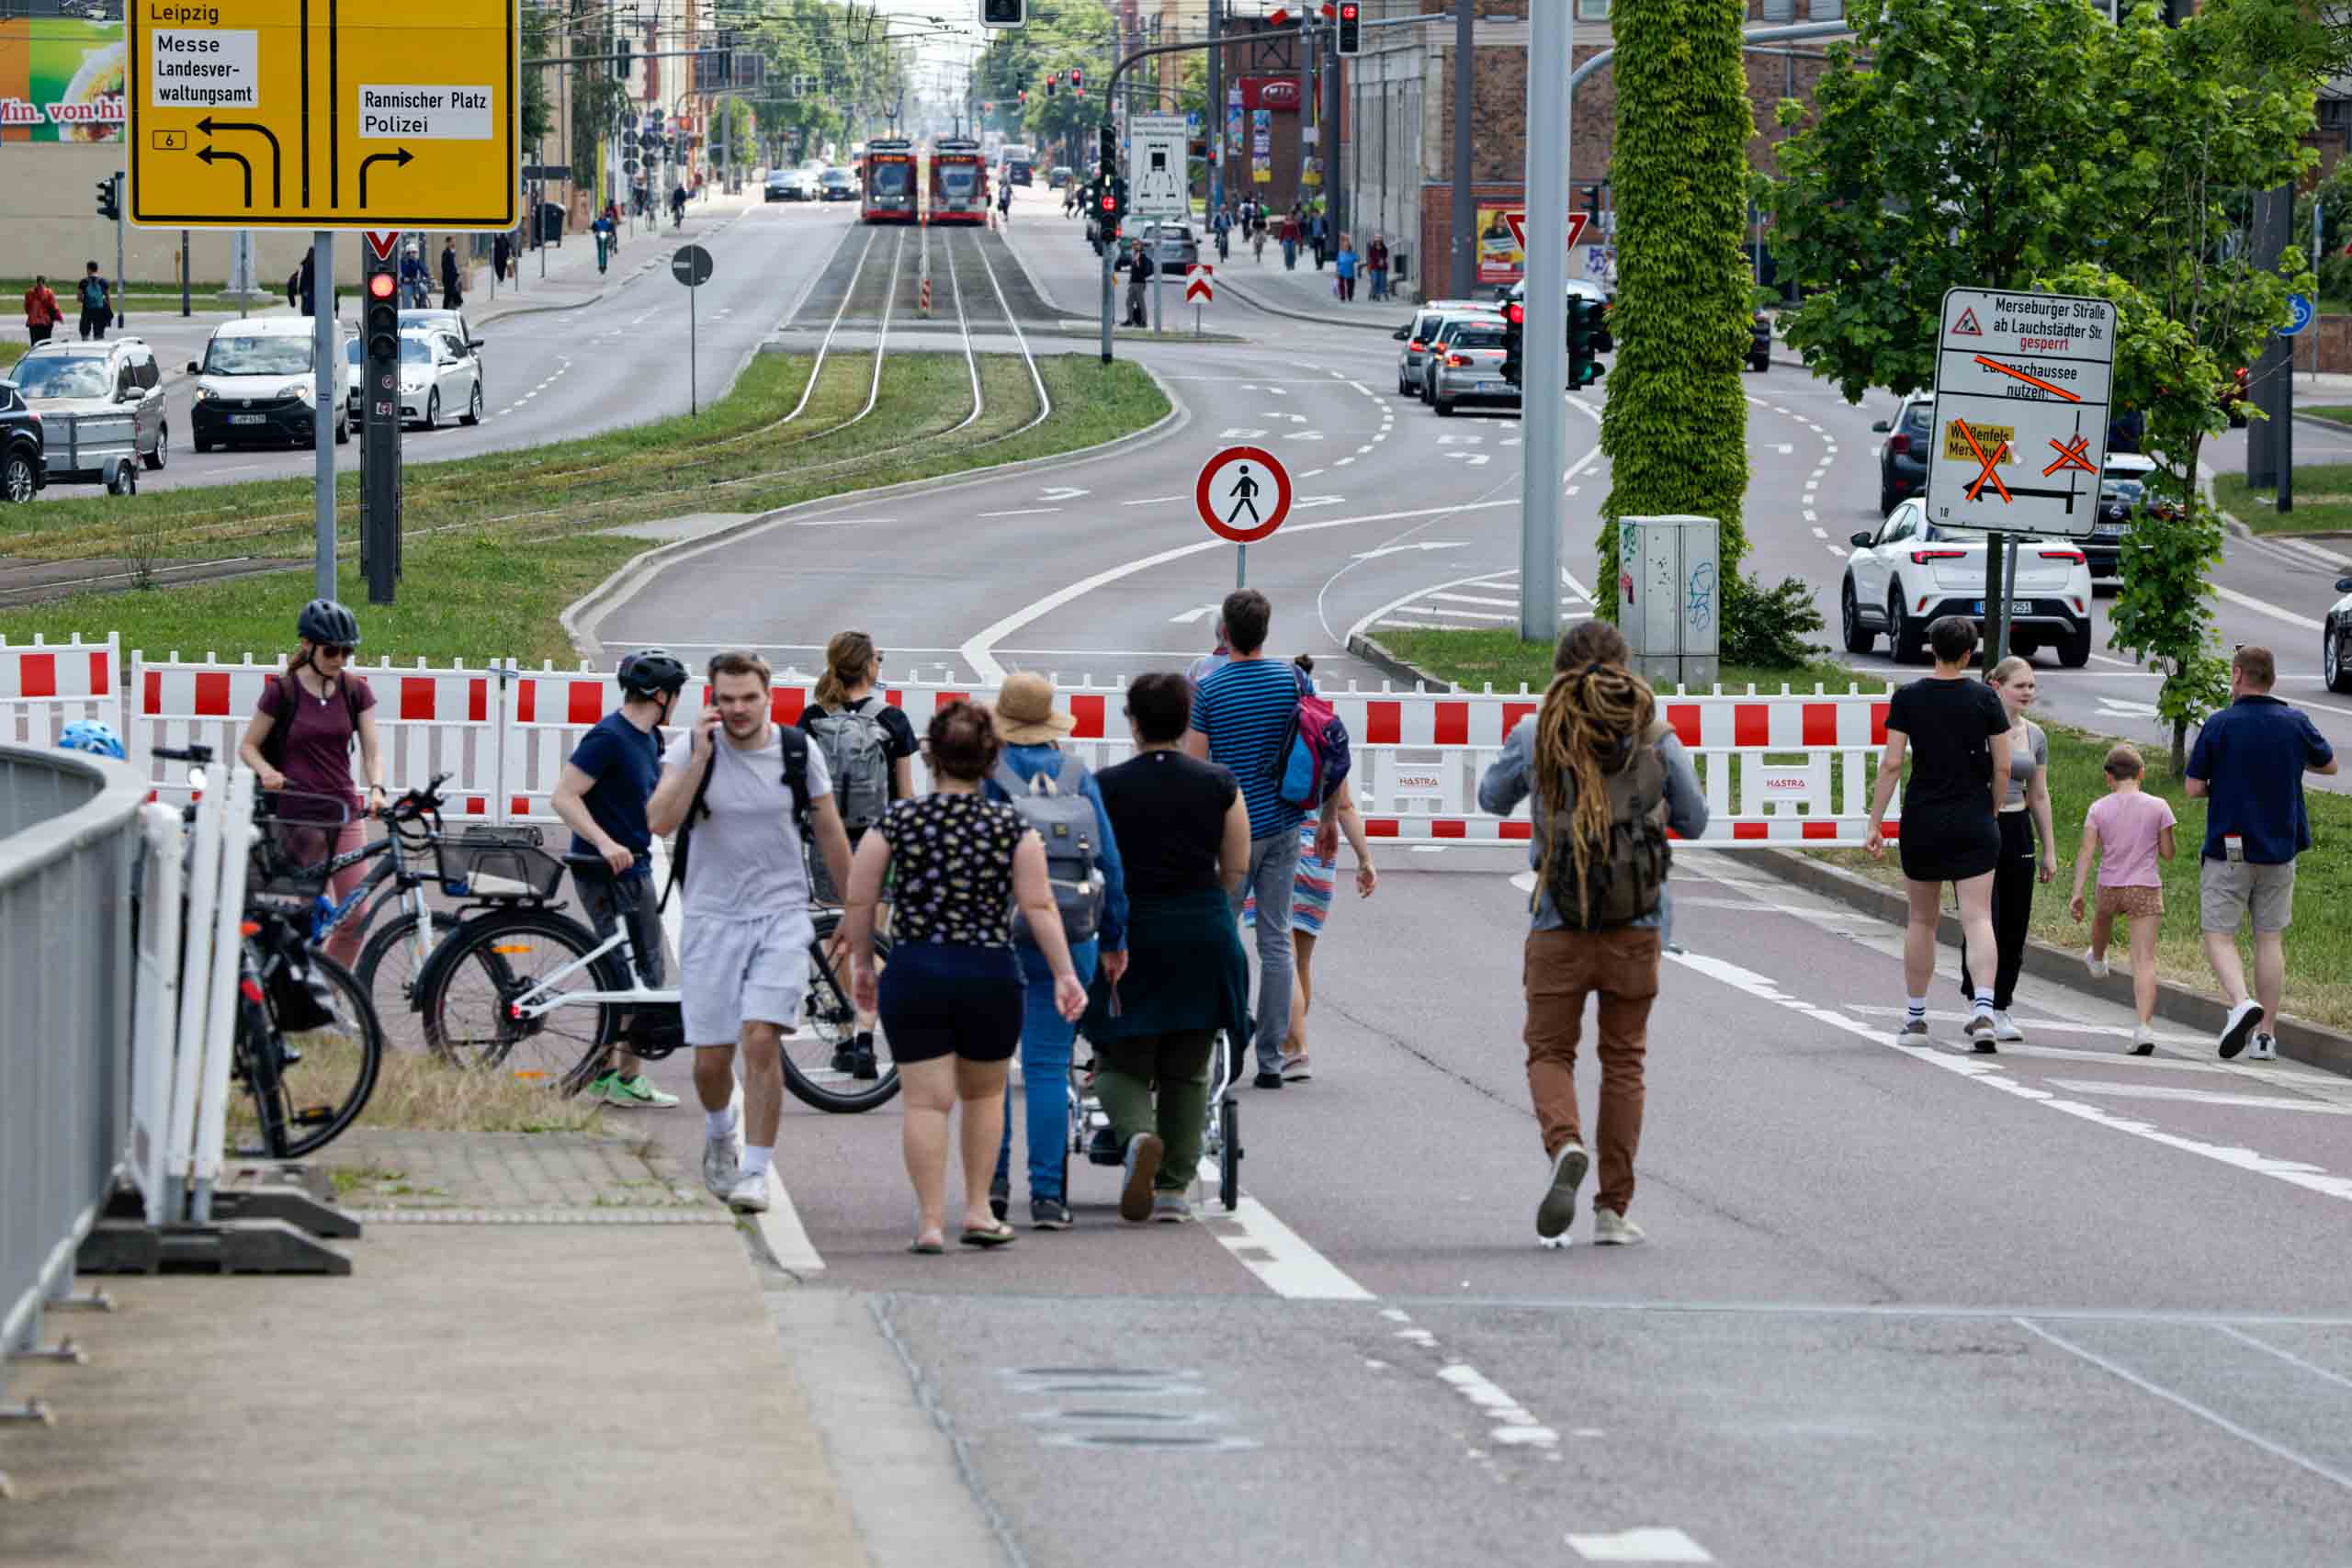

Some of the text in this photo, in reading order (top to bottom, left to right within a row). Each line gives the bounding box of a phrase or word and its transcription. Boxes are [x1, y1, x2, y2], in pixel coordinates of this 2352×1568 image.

[151, 4, 220, 25] Leipzig
[157, 35, 220, 52] Messe
[158, 60, 241, 77] Landesver-
[159, 85, 253, 106] waltungsamt
[365, 91, 487, 109] Rannischer Platz
[49, 103, 94, 120] von
[365, 116, 428, 133] Polizei
[165, 133, 174, 147] 6
[1995, 298, 2106, 321] Merseburger Straße
[1994, 317, 2103, 340] ab Lauchstädter Str.
[2019, 337, 2069, 354] gesperrt
[1951, 425, 2010, 443] Wßenfels
[1949, 442, 2007, 463] Mersbug
[1399, 778, 1439, 787] HASTRA
[1767, 778, 1806, 787] HASTRA
